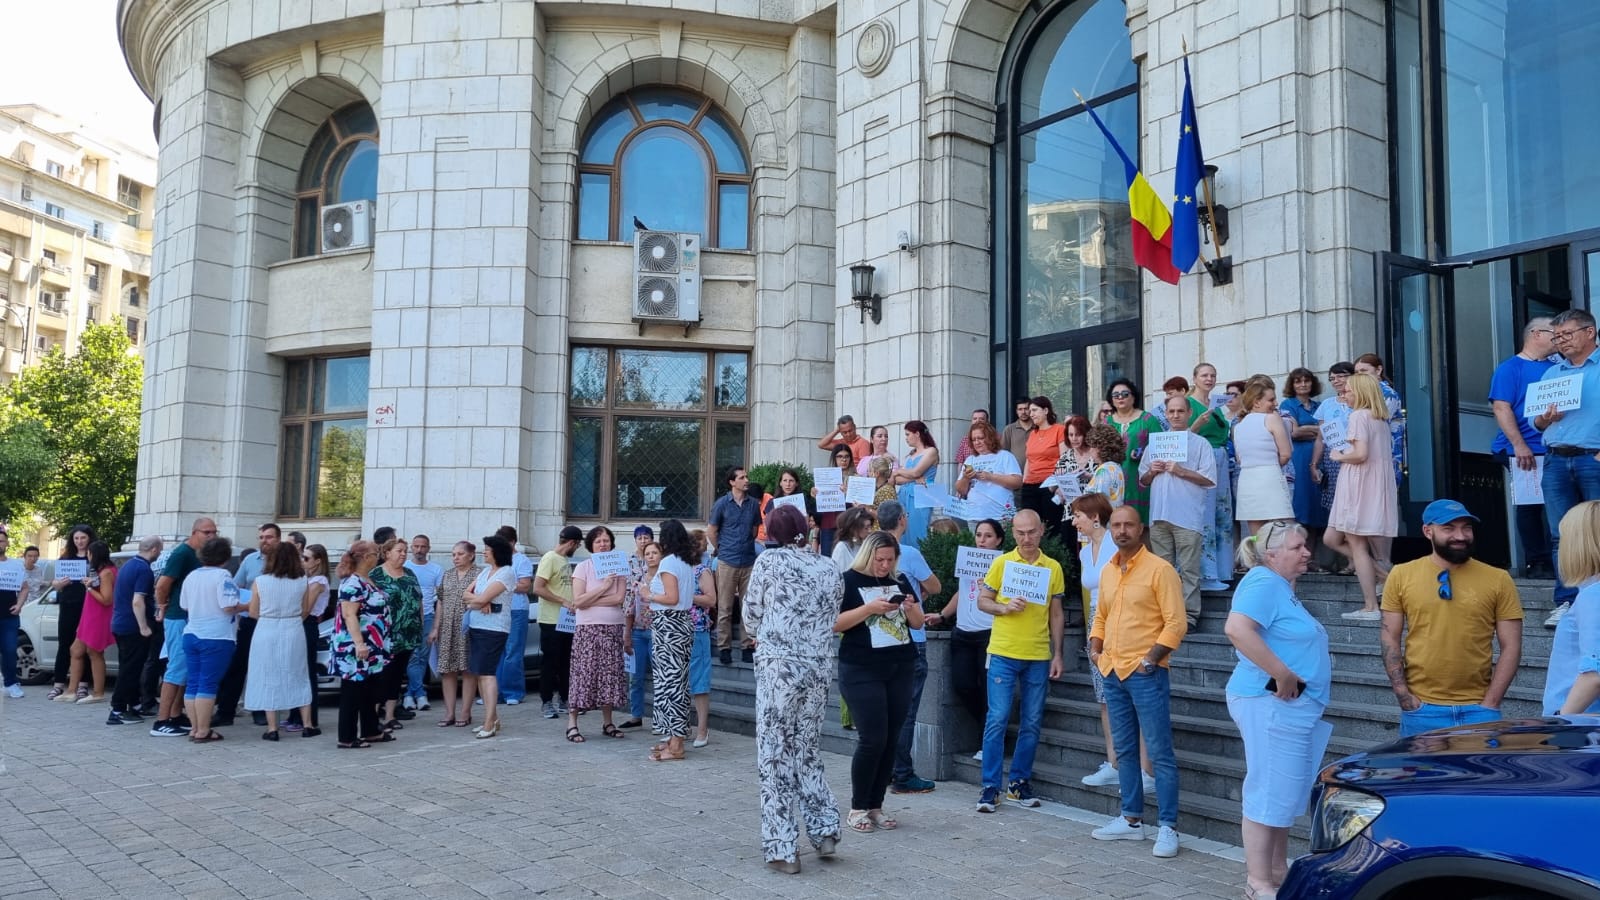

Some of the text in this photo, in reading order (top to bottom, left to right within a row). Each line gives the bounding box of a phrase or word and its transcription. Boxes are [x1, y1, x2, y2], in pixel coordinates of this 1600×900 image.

[1537, 379, 1571, 391] RESPECT
[1537, 390, 1570, 401] PENTRU
[967, 551, 995, 560] RESPECT
[966, 560, 991, 569] PENTR
[957, 568, 987, 578] STATISTIC
[1013, 566, 1041, 578] RESPECT
[1003, 586, 1047, 601] STATISTICIAN
